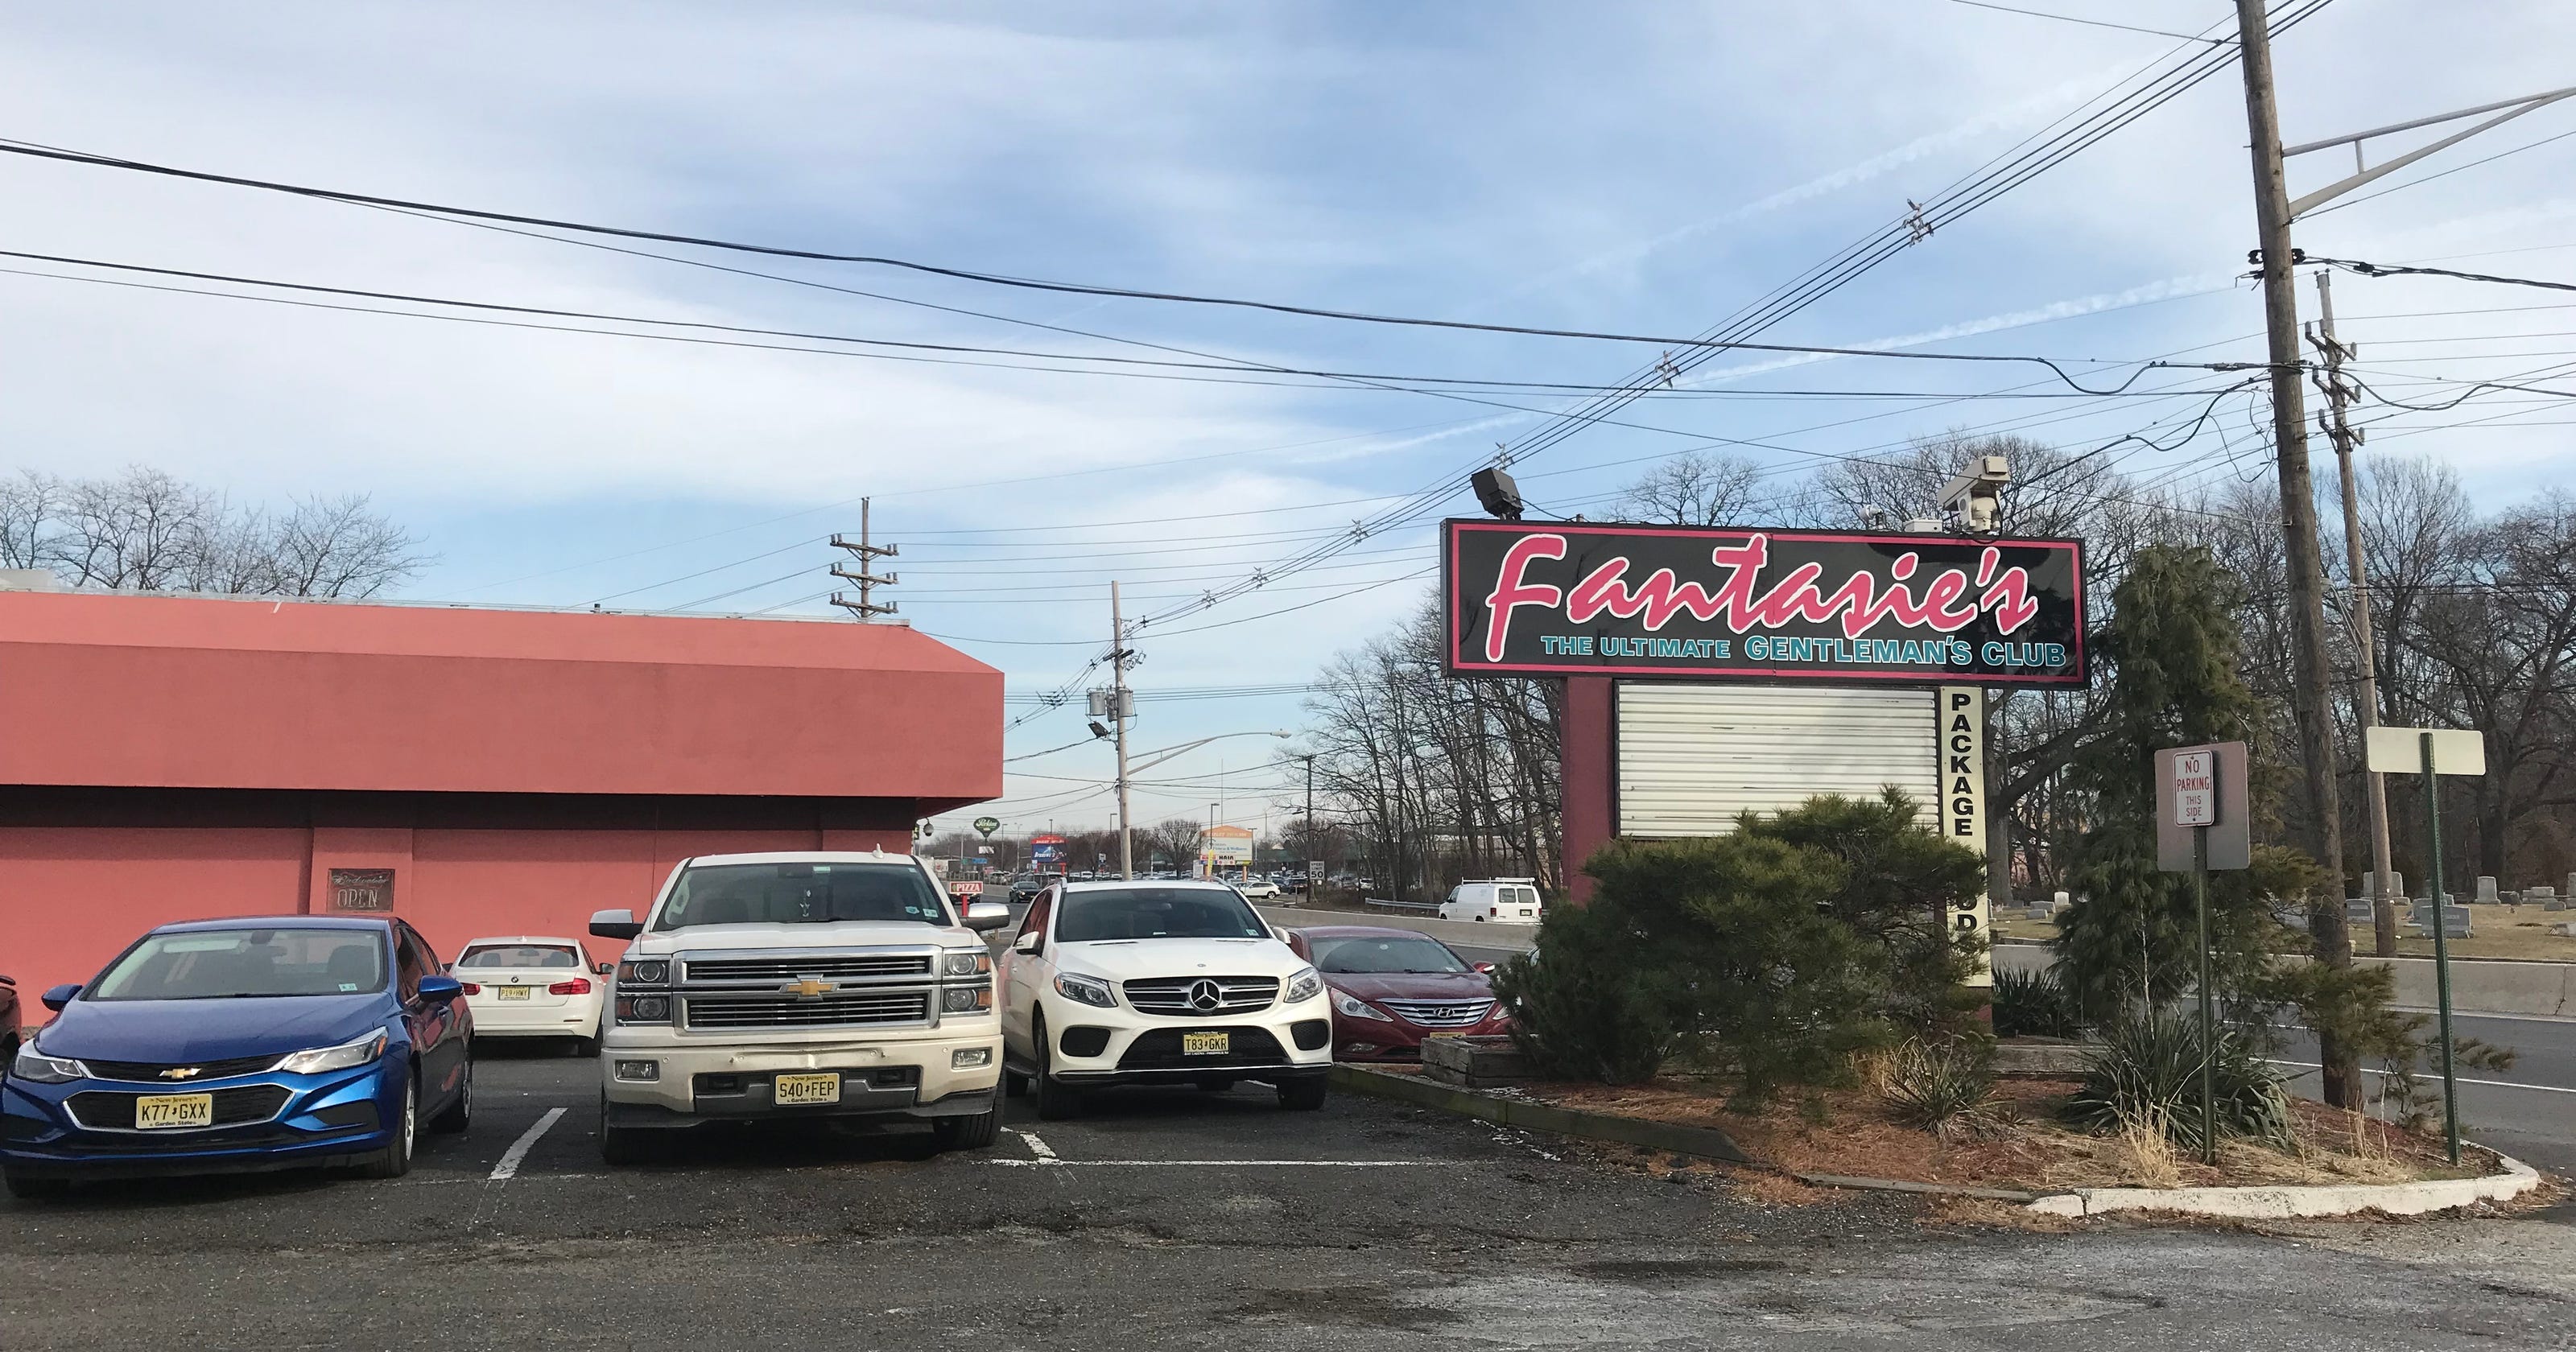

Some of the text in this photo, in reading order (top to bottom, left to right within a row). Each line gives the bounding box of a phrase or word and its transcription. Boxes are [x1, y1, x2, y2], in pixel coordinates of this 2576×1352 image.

[1485, 533, 2038, 662] Fantasie's
[1540, 634, 2066, 668] THE ULTIMATE GENTLEMAN'S CLUB
[1951, 693, 1974, 836] PACKAGE
[2185, 759, 2200, 773] NO
[2177, 776, 2210, 793] PARKING
[2186, 795, 2202, 806] THIS
[2186, 806, 2202, 817] SIDE
[956, 883, 980, 892] PIZZA
[337, 888, 378, 908] OPEN
